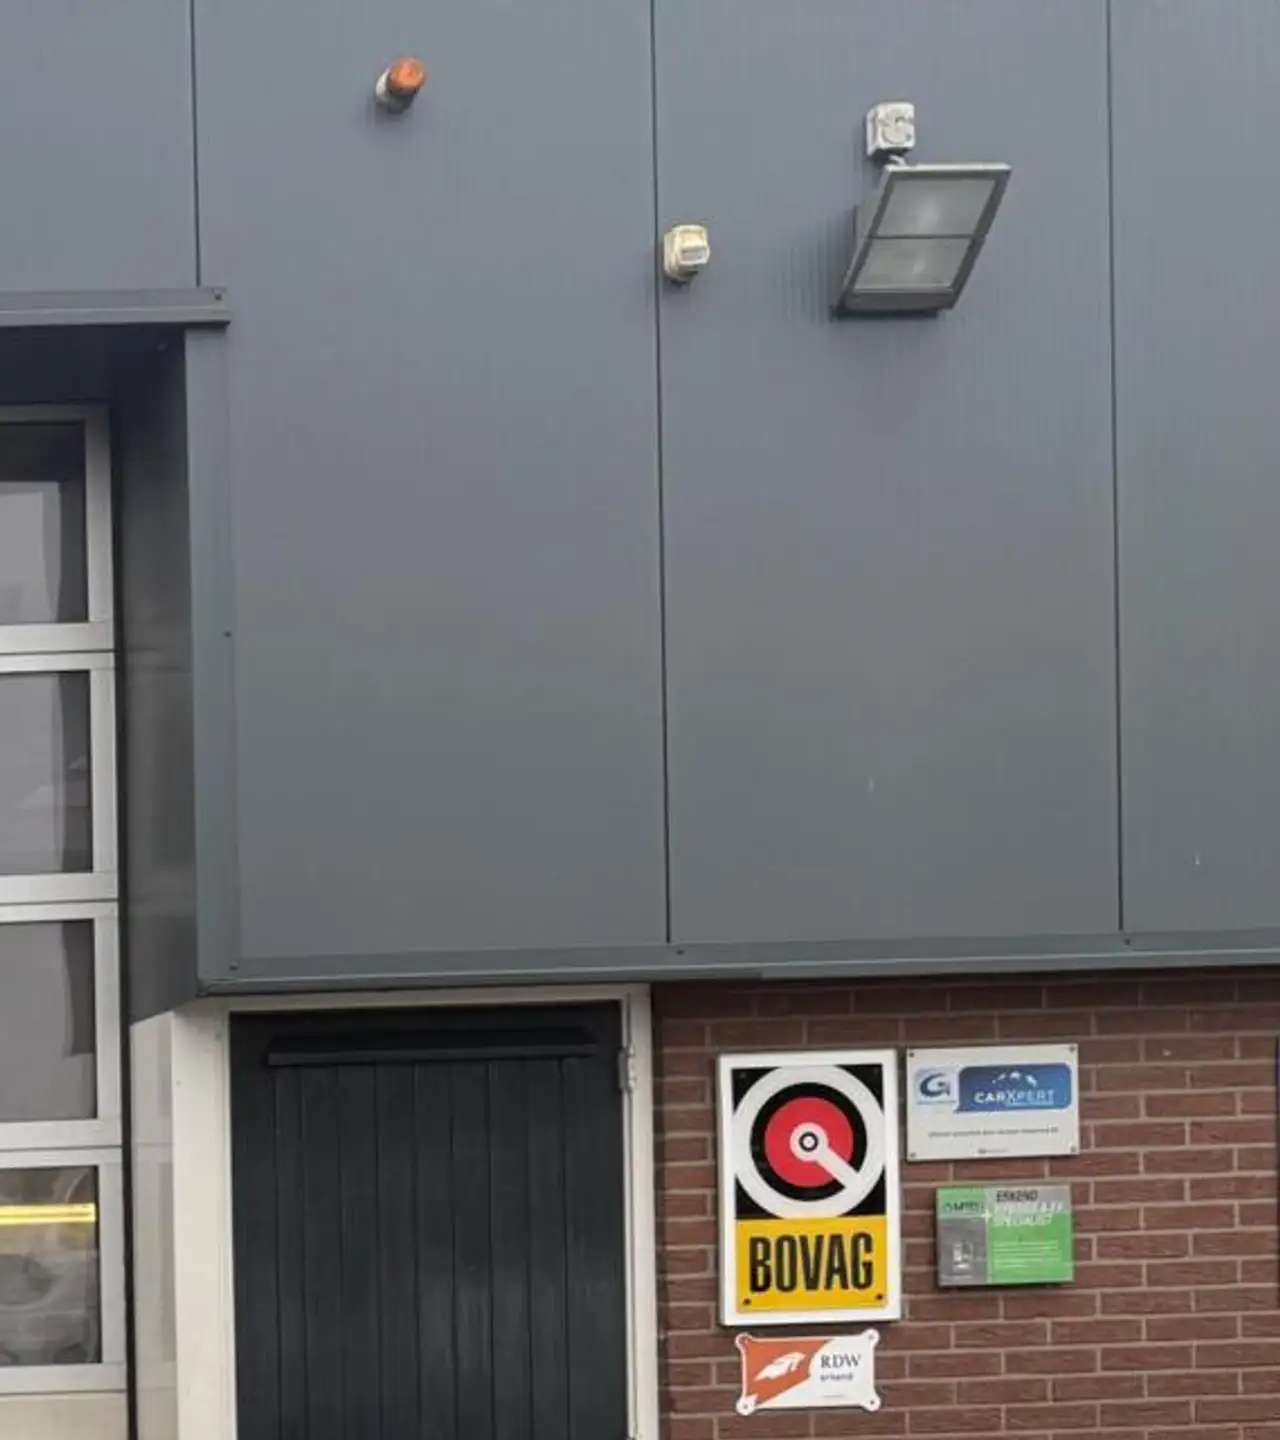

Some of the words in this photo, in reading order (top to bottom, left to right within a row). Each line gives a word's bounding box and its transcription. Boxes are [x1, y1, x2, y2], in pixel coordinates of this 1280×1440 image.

[974, 1088, 1056, 1104] CARXPERT
[749, 1232, 873, 1293] BOVAG
[821, 1353, 862, 1369] RDW
